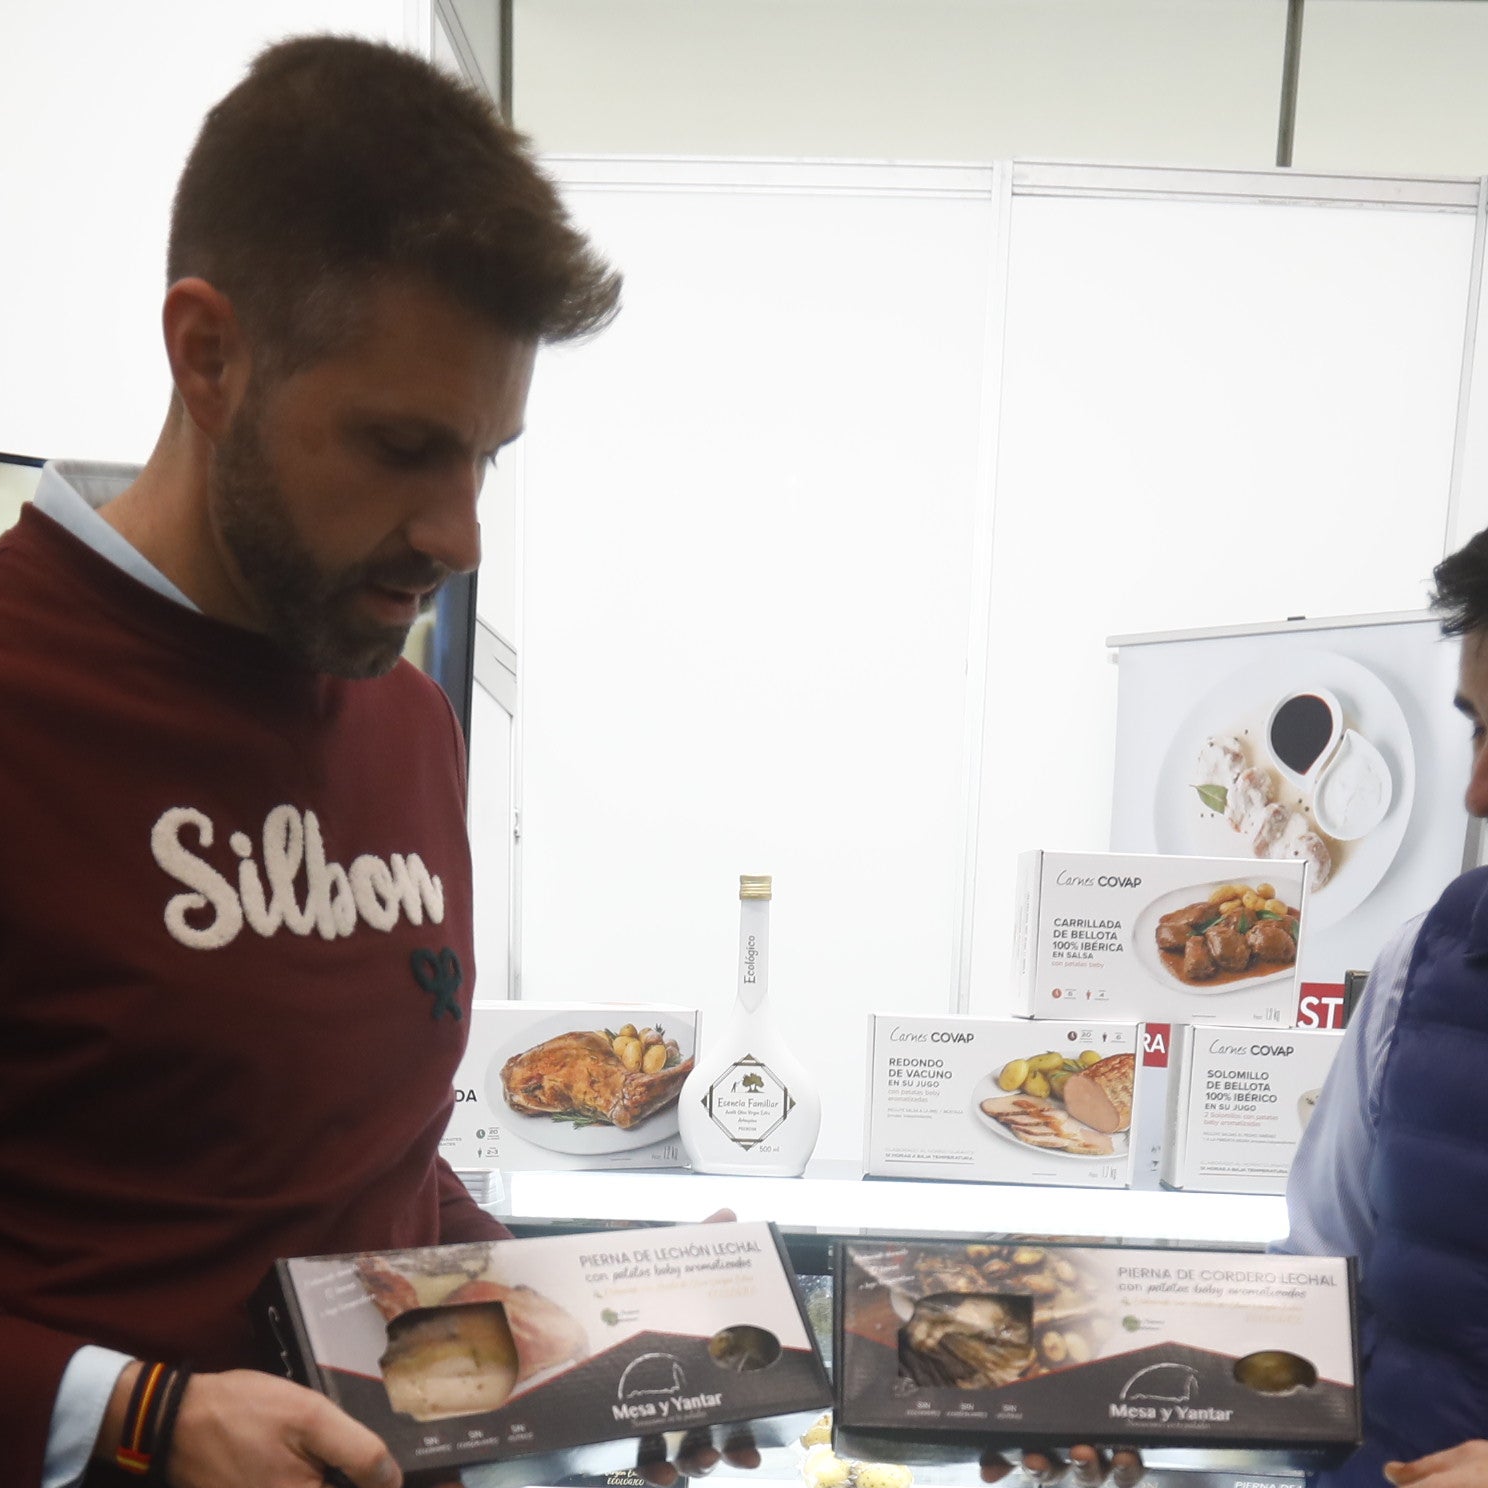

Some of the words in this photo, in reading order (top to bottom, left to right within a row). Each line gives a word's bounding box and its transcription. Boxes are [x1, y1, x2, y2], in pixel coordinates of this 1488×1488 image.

[151, 804, 444, 950] Silbon
[1056, 869, 1094, 887] Carnes
[1097, 876, 1142, 889] COVAP
[1053, 917, 1122, 930] CARRILLADA
[1052, 929, 1068, 940] DE
[1070, 930, 1118, 942] BELLOTA
[1052, 940, 1079, 951] 100%
[1080, 939, 1124, 952] IBÉRICA
[744, 935, 759, 985] Ecológico
[1052, 951, 1064, 959] EN
[1066, 952, 1094, 960] SALSA
[1298, 996, 1344, 1029] ST
[889, 1026, 928, 1043] Carnes
[931, 1032, 974, 1044] COVAP
[1209, 1038, 1247, 1055] Carnes
[1250, 1045, 1294, 1057] COVAP
[889, 1057, 944, 1068] REDONDO
[888, 1069, 904, 1079] DE
[906, 1070, 953, 1080] VACUNO
[1207, 1069, 1269, 1081] SOLOMILLO
[888, 1079, 900, 1087] EN
[902, 1080, 914, 1088] SU
[916, 1080, 940, 1088] JUGO
[1206, 1080, 1221, 1090] DE
[1224, 1081, 1271, 1092] BELLOTA
[717, 1097, 745, 1108] Esencia
[748, 1098, 779, 1109] Familiar
[1205, 1092, 1231, 1101] 100%
[1233, 1091, 1277, 1103] IBÉRICO
[1218, 1103, 1230, 1111] SU
[1233, 1104, 1257, 1112] JUGO
[579, 1251, 631, 1268] PIERNA
[633, 1249, 650, 1263] DE
[654, 1243, 710, 1261] LECHÓN
[712, 1240, 762, 1256] LECHAL
[585, 1273, 609, 1283] con
[1118, 1266, 1172, 1279] PIERNA
[1177, 1268, 1194, 1280] DE
[1200, 1269, 1277, 1284] CORDERO
[1281, 1272, 1337, 1287] LECHAL
[1119, 1283, 1143, 1292] con
[612, 1400, 657, 1421] Mesa
[660, 1400, 671, 1417] y
[670, 1391, 723, 1414] Yantar
[1109, 1403, 1157, 1419] Mesa
[1161, 1406, 1173, 1423] y
[1174, 1405, 1234, 1423] Yantar
